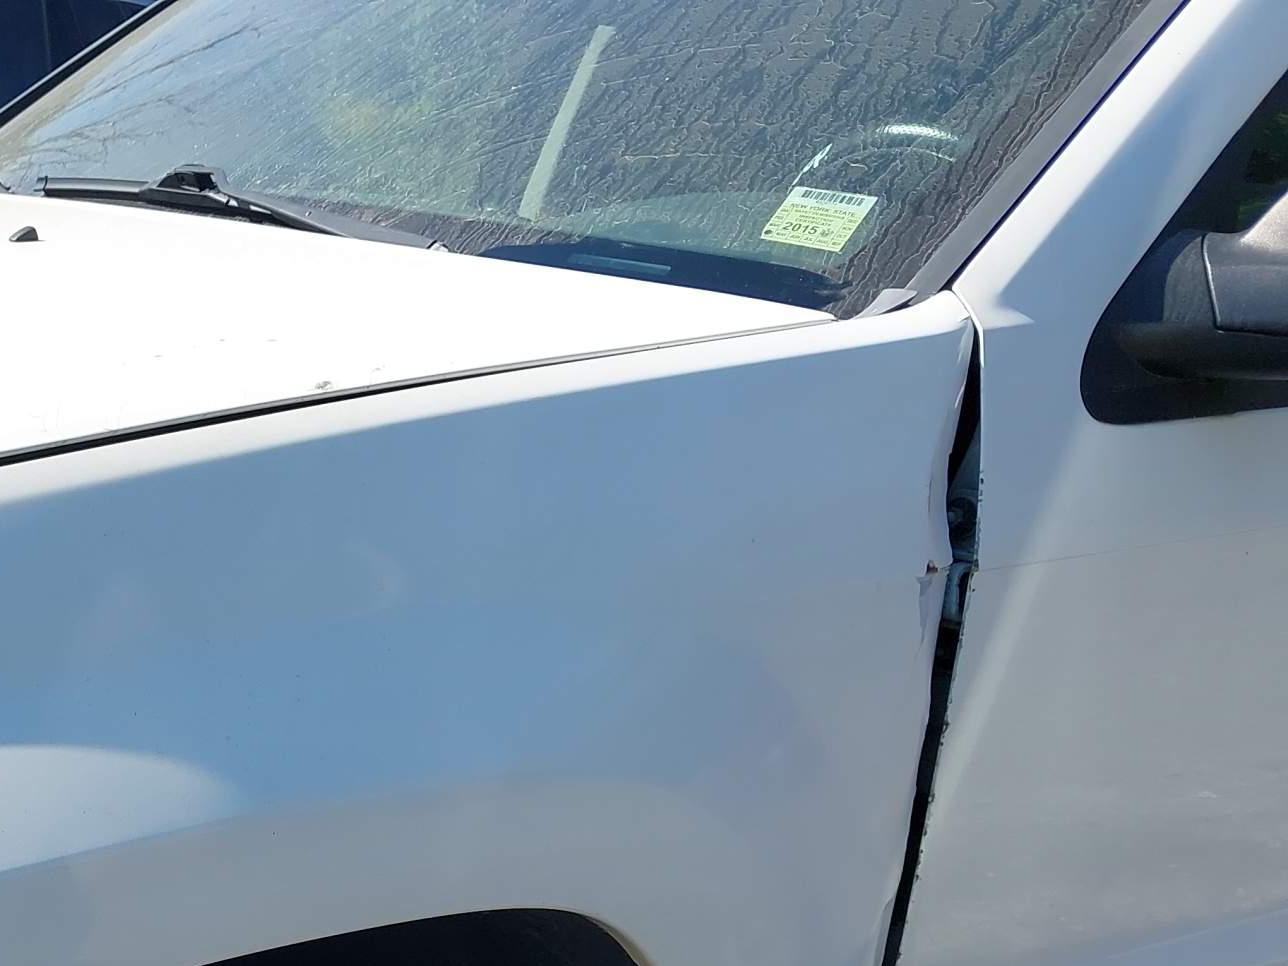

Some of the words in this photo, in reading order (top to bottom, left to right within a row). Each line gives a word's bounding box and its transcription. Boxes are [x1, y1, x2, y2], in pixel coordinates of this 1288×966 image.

[809, 204, 830, 213] YORK
[833, 208, 857, 217] STATE
[782, 221, 820, 235] 2015
